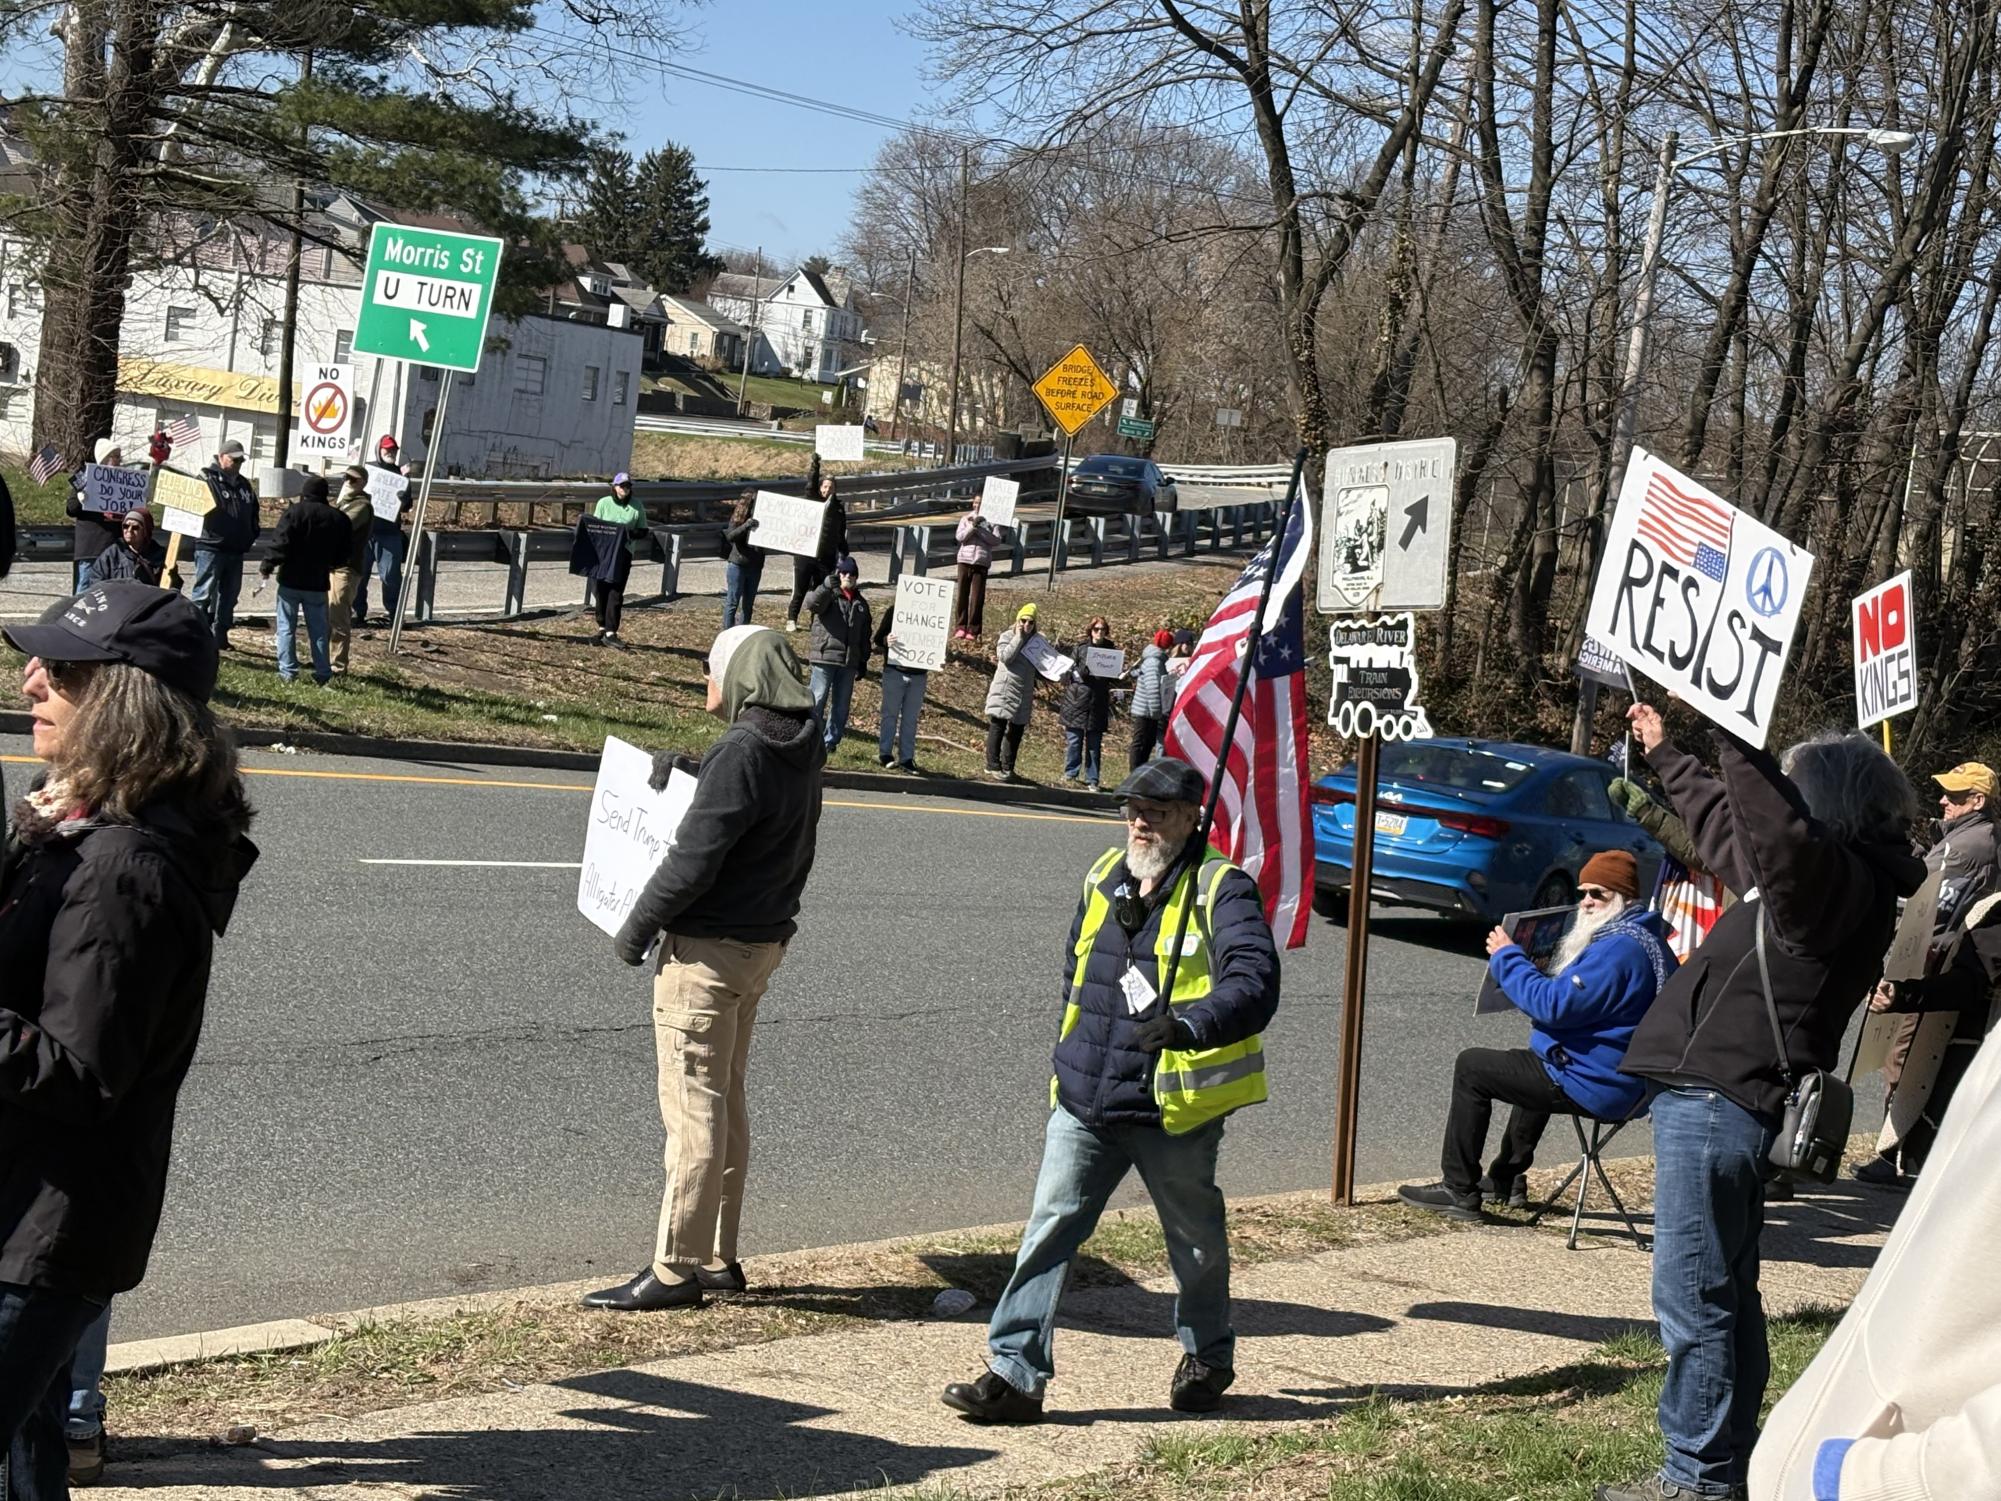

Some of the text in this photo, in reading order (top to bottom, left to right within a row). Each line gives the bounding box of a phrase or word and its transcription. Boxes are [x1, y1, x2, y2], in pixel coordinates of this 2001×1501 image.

[384, 236, 485, 275] Morris St
[384, 276, 472, 312] U TURN
[318, 367, 340, 381] NO
[1062, 363, 1093, 374] BRIDGE
[127, 362, 223, 401] Luxury
[1057, 376, 1096, 387] FREEZES
[1045, 388, 1104, 400] BEFORE ROAD
[1054, 401, 1093, 413] SURFACE
[300, 434, 346, 449] KINGS
[93, 465, 147, 488] CONGRESS
[1336, 457, 1444, 485] BUSINESS DISTRICT
[99, 484, 143, 502] DO YOUR
[988, 479, 1014, 496] HATE
[99, 496, 134, 514] JOB!
[759, 497, 821, 521] DEMOCRACY
[761, 532, 808, 551] COURAGE
[904, 580, 947, 598] VOTE
[911, 600, 937, 611] FOR
[896, 611, 945, 629] CHANGE
[1858, 584, 1906, 664] NO
[1336, 627, 1406, 645] DELAWARE RIVER
[1608, 538, 1783, 727] RESIST
[901, 649, 936, 666] 026
[1360, 670, 1388, 685] TRAIN
[1860, 648, 1912, 720] KINGS
[1348, 687, 1402, 700] EXCURSIONS
[597, 789, 633, 835] Send
[633, 806, 661, 861] Trump
[585, 862, 621, 913] Alligator
